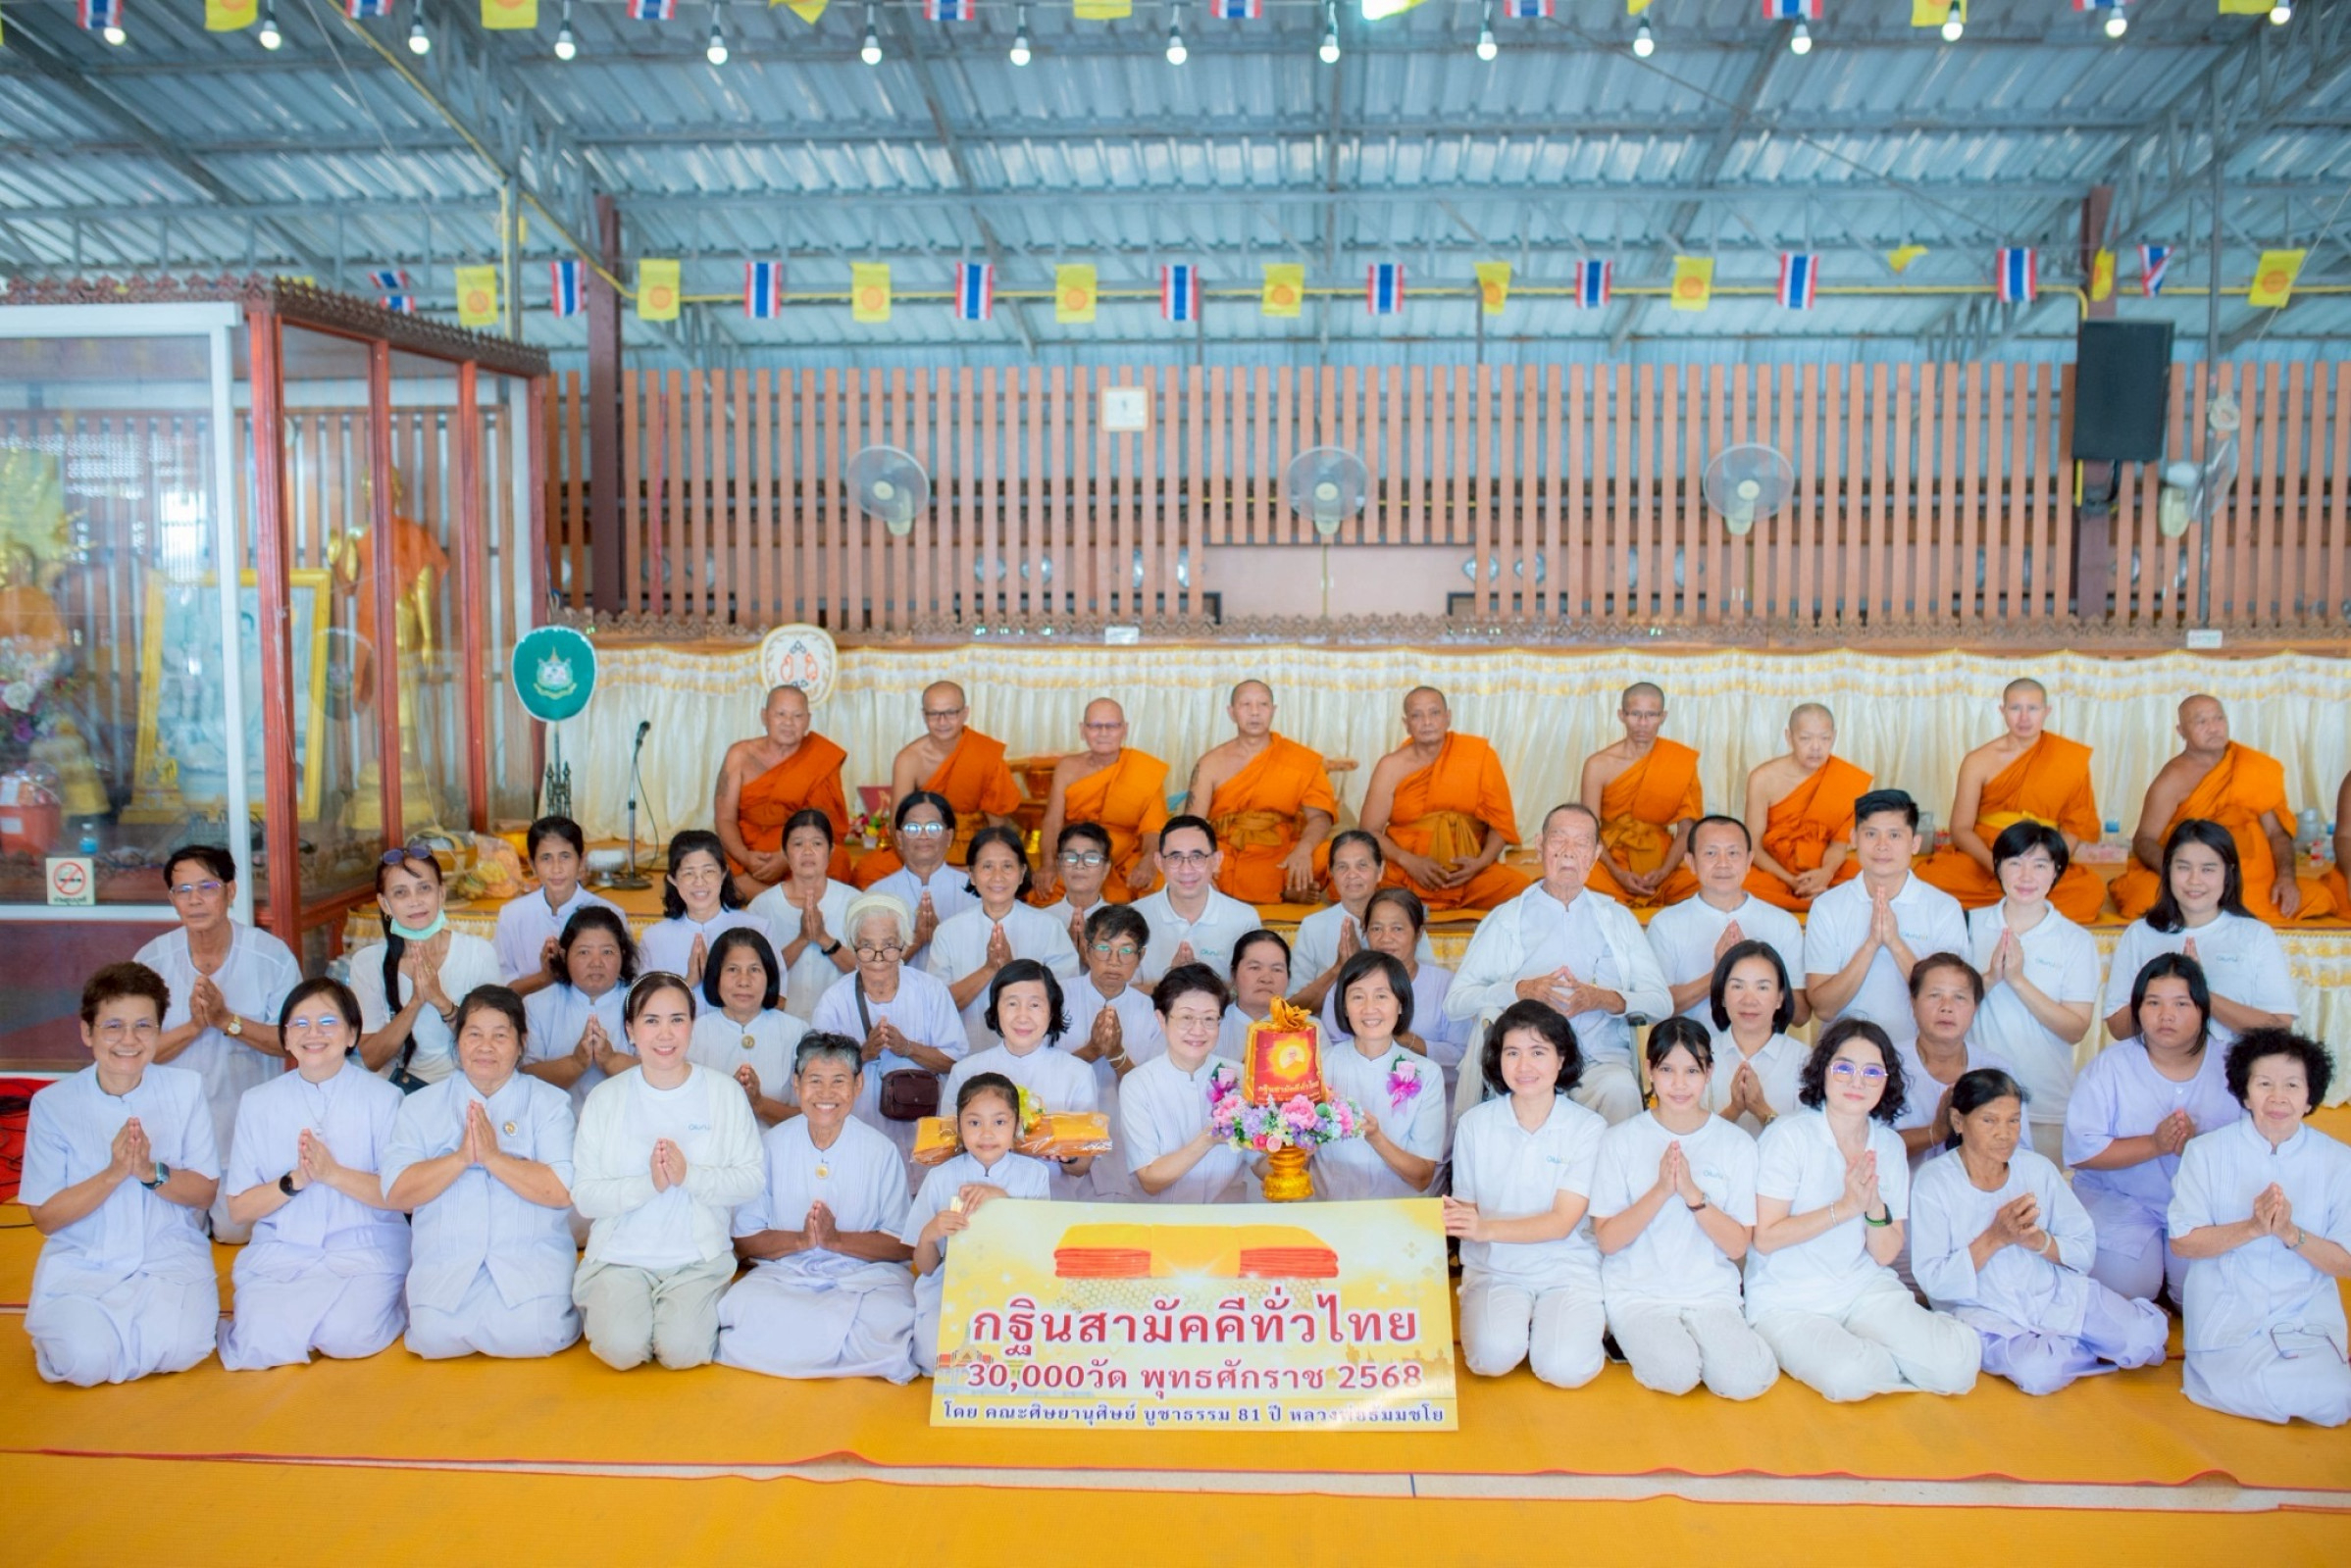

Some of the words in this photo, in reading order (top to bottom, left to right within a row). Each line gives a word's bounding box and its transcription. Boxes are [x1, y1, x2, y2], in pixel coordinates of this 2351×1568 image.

[974, 1287, 1416, 1356] กฐินสามัคคีทั่วไทย
[967, 1358, 1127, 1392] 30,000วัด
[1141, 1359, 1323, 1399] พุทธศักราช
[1338, 1364, 1421, 1389] 2568
[944, 1400, 978, 1419] โดย
[986, 1403, 1136, 1426] คณะศิษยานุศิษย์
[1144, 1406, 1230, 1427] บูชาธรรม
[1239, 1408, 1260, 1421] 81
[1268, 1404, 1281, 1422] ปี
